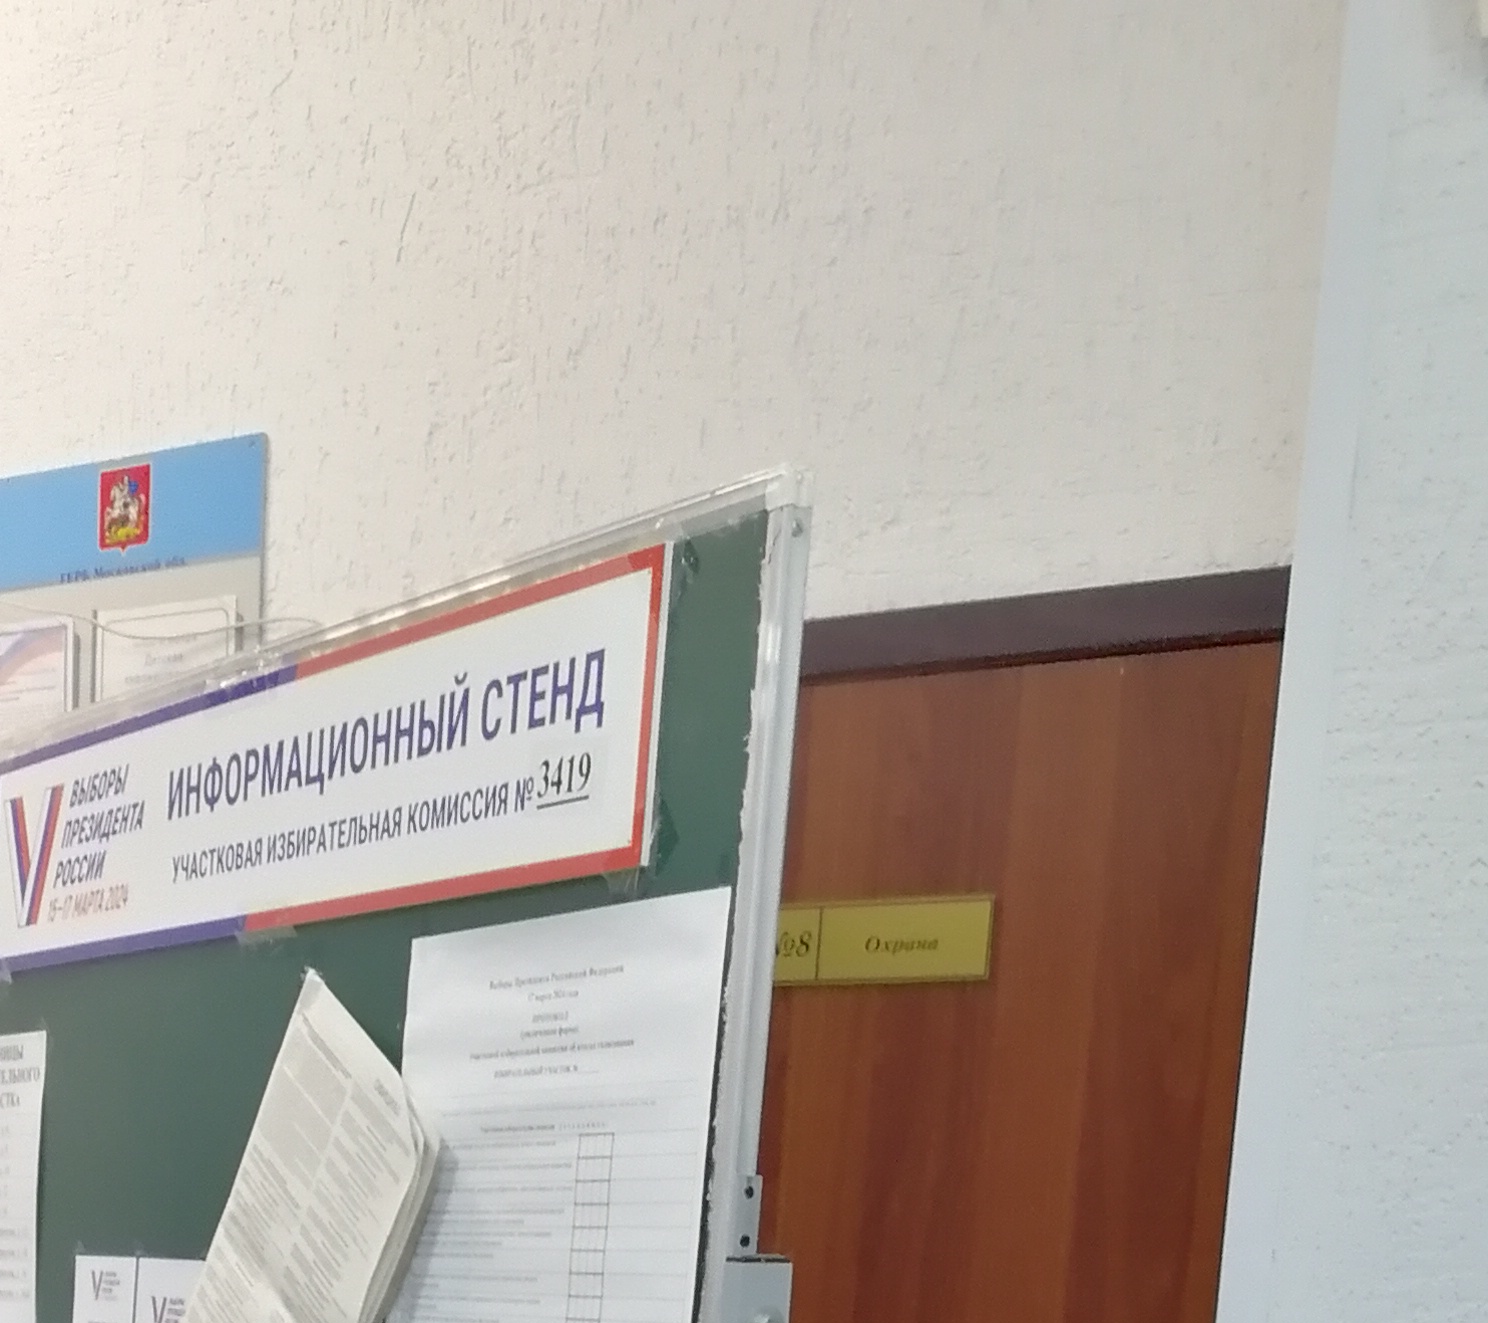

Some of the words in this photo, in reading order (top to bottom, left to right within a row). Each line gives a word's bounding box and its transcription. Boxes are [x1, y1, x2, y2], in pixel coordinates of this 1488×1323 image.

[167, 672, 470, 821] ИНФОРМАЦИОННЫЙ
[480, 648, 606, 741] СТЕНД
[69, 764, 130, 808] ВЫБОРЫ
[61, 800, 146, 848] ПРЕЗИДЕНТА
[171, 838, 263, 883] УЧАСТКОВАЯ
[267, 806, 402, 864] ИЗБИРАТЕЛЬНАЯ
[407, 783, 509, 835] КОМИССИЯ
[53, 850, 107, 889] РОССИИ
